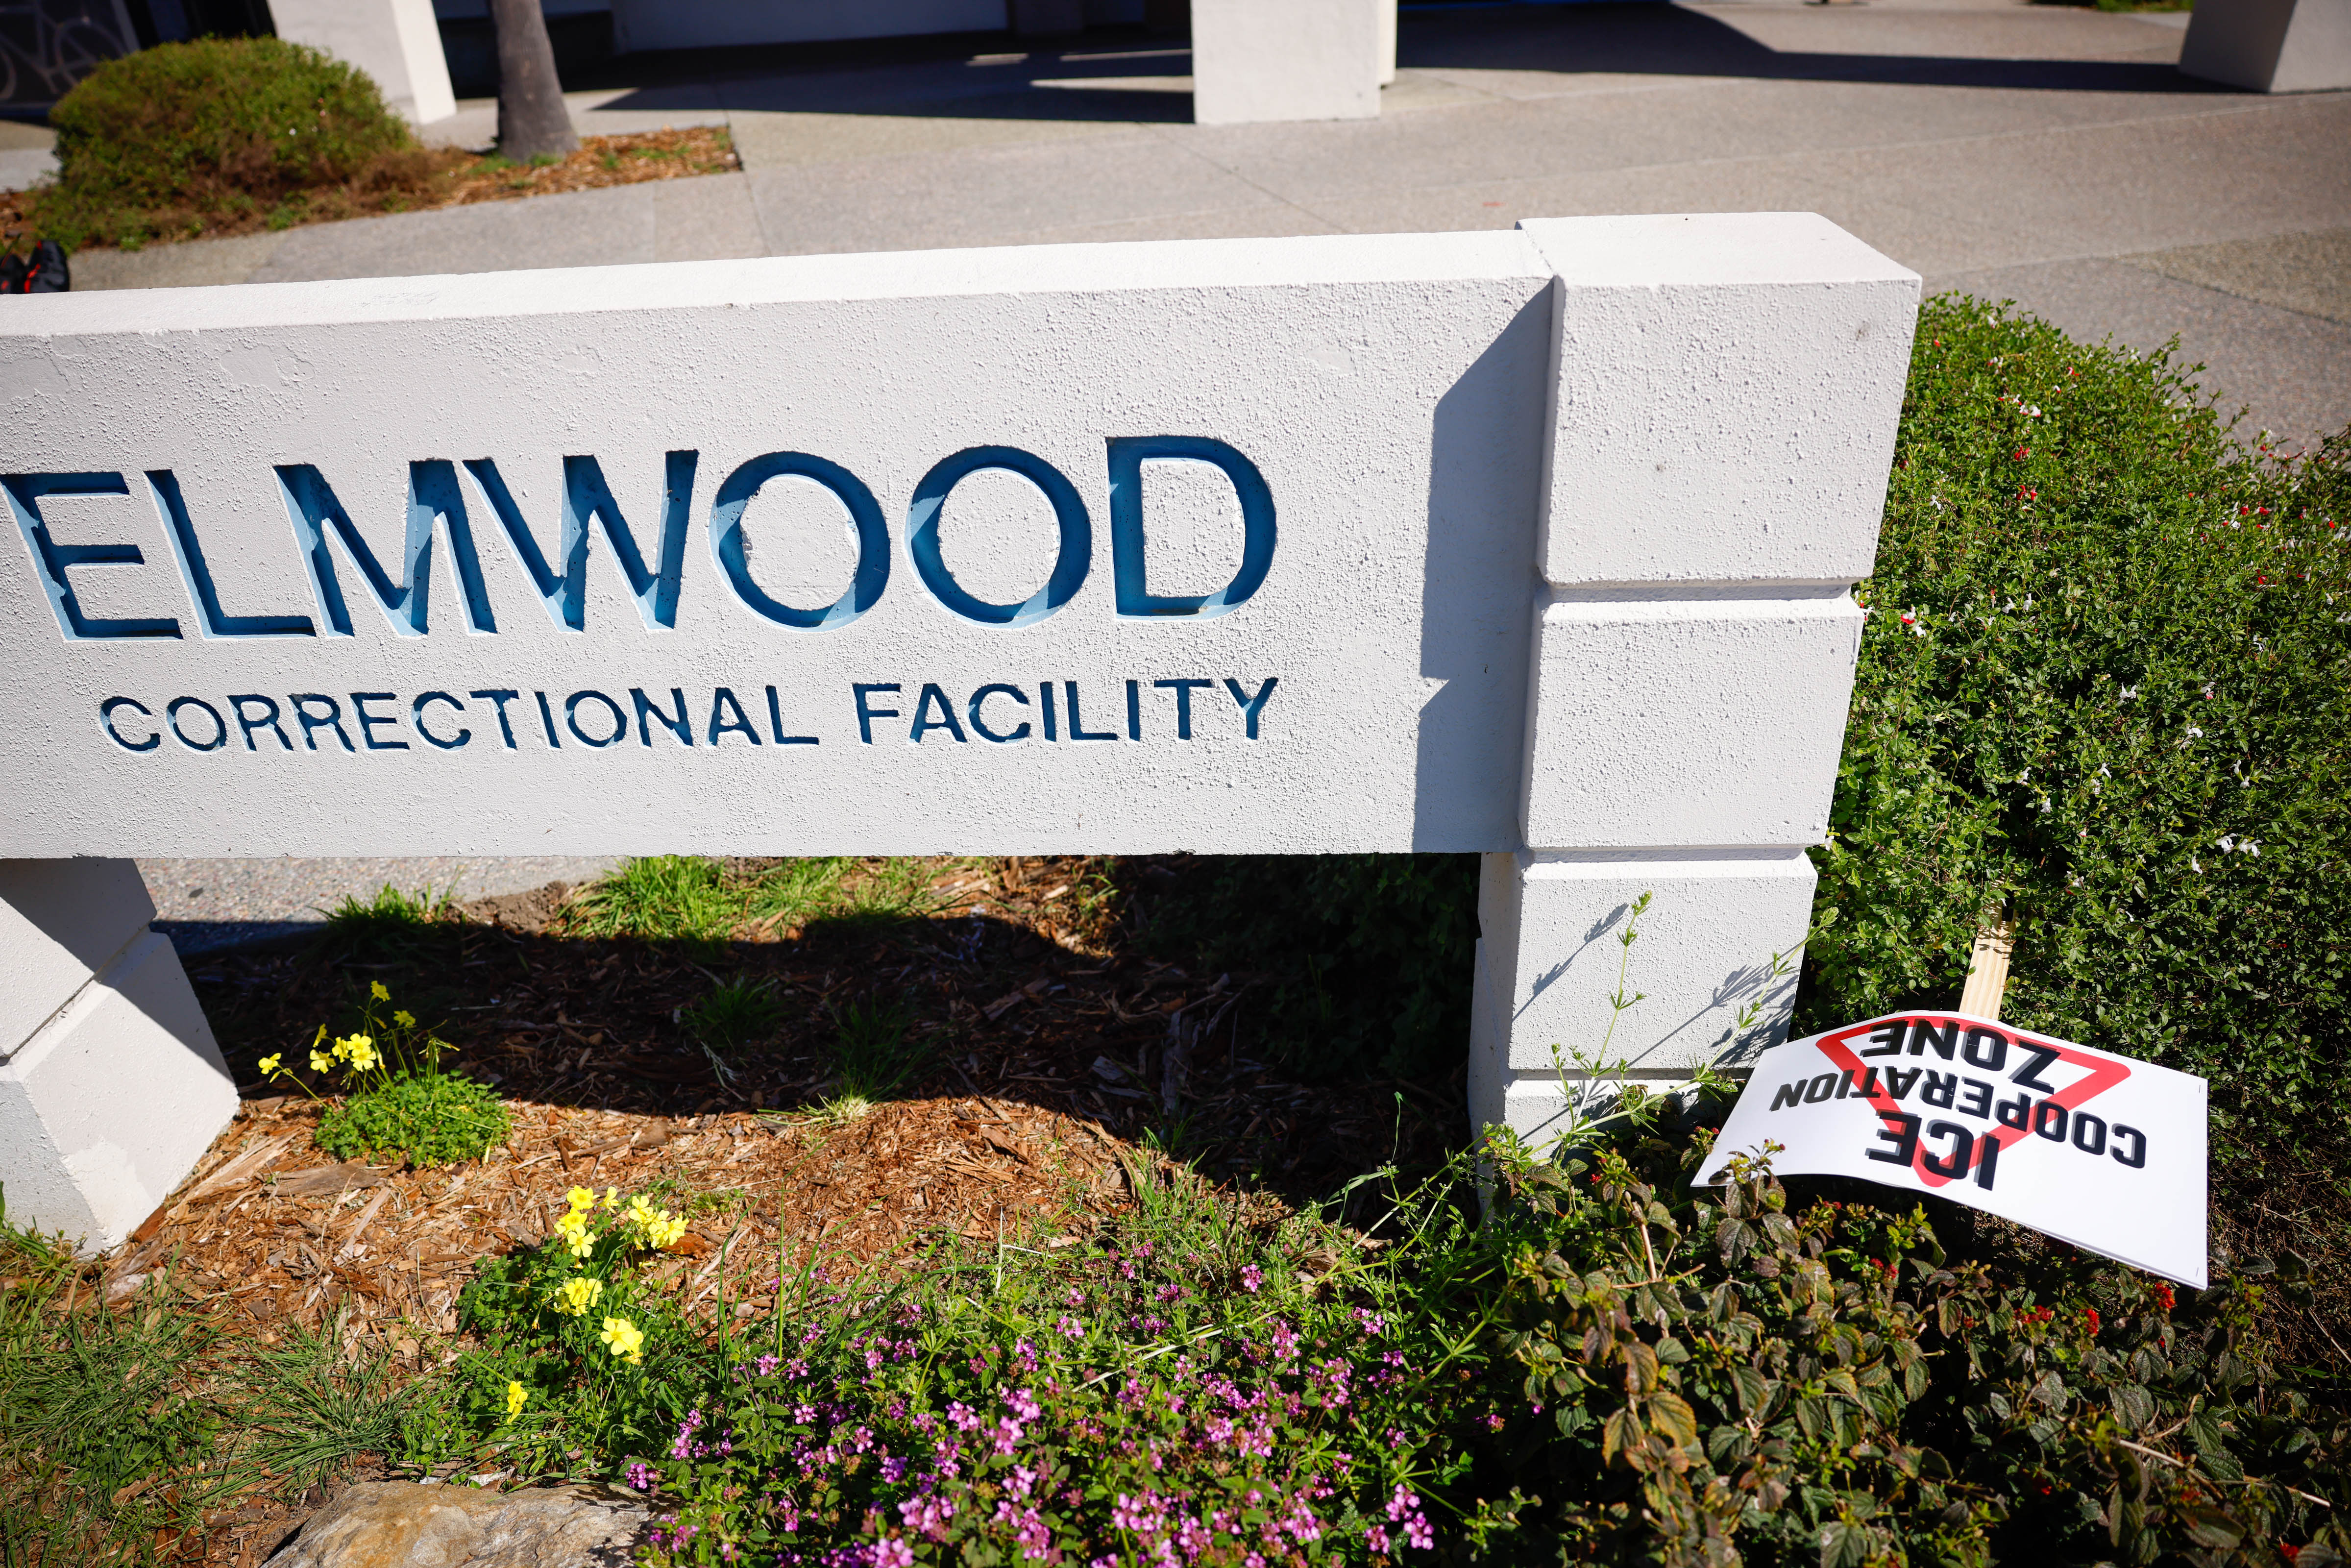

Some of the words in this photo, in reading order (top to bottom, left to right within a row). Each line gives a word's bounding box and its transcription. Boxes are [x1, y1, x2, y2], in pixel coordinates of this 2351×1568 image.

[0, 436, 1277, 641] ELMWOOD
[100, 685, 819, 753] CORRECTIONAL
[852, 677, 1278, 745] FACILITY
[1861, 1018, 2061, 1094] ZONE
[1769, 1067, 2146, 1169] COOPERATION
[1865, 1109, 2000, 1191] ICE
